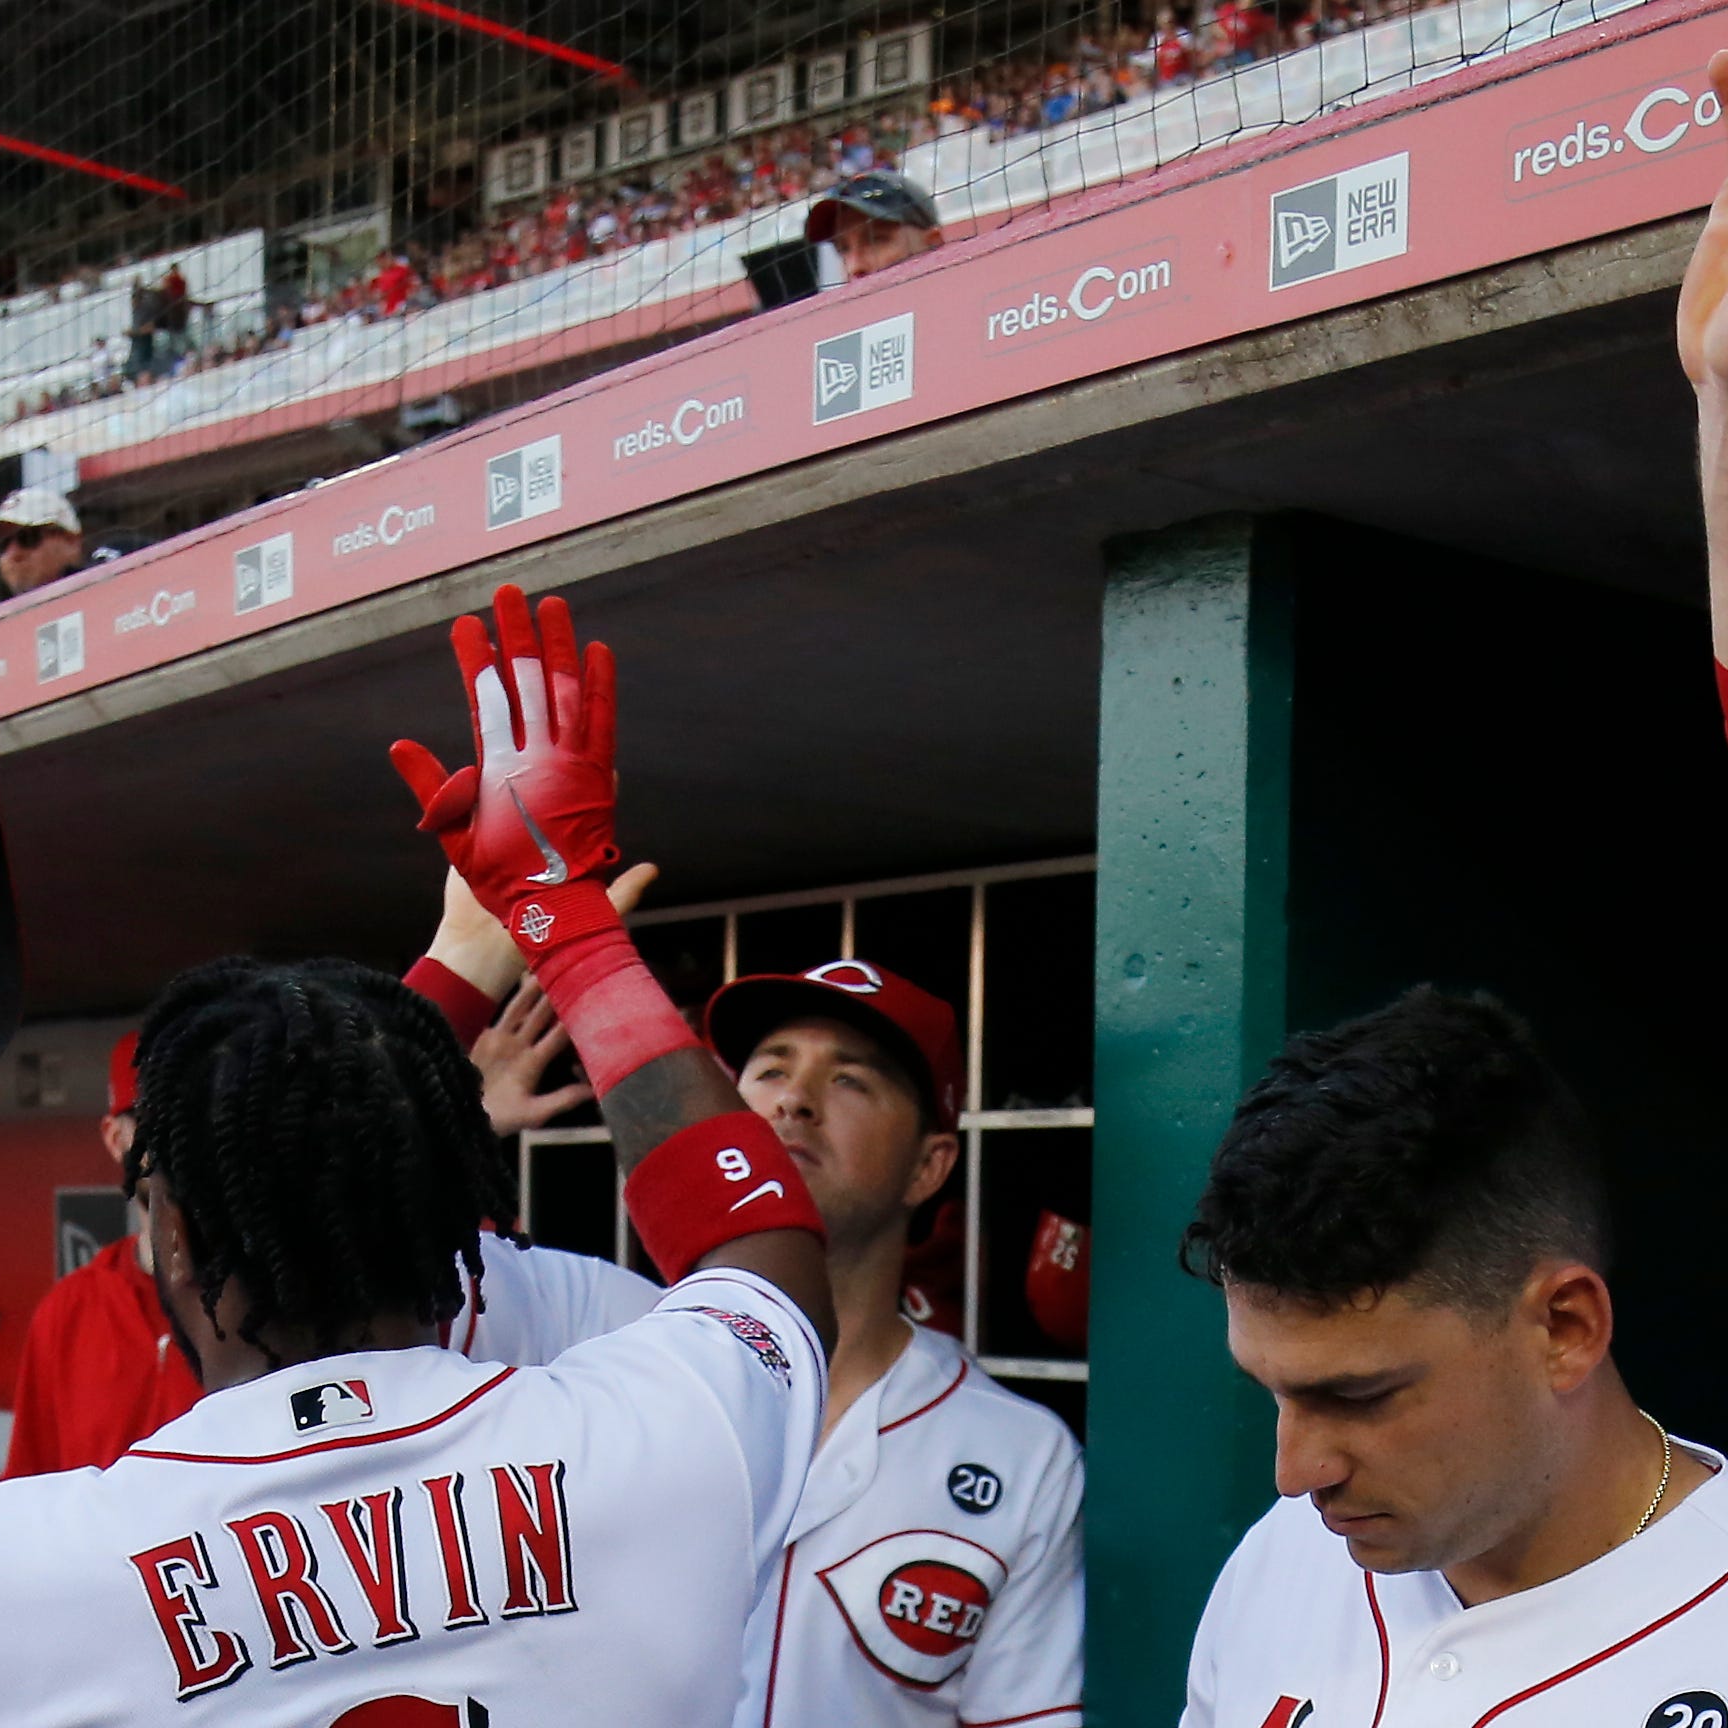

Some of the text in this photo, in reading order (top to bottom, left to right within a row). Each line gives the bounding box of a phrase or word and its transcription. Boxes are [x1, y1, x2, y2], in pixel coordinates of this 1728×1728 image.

[1347, 178, 1397, 215] NEW
[1346, 213, 1397, 247] ERA
[988, 258, 1171, 341] reds.Com
[869, 334, 906, 365] NEW
[869, 358, 905, 391] ERA
[613, 395, 745, 460] reds.Com
[333, 504, 435, 557] reds.Com
[953, 1467, 998, 1508] 20
[127, 1459, 579, 1703] ERVIN
[884, 1579, 984, 1639] RED
